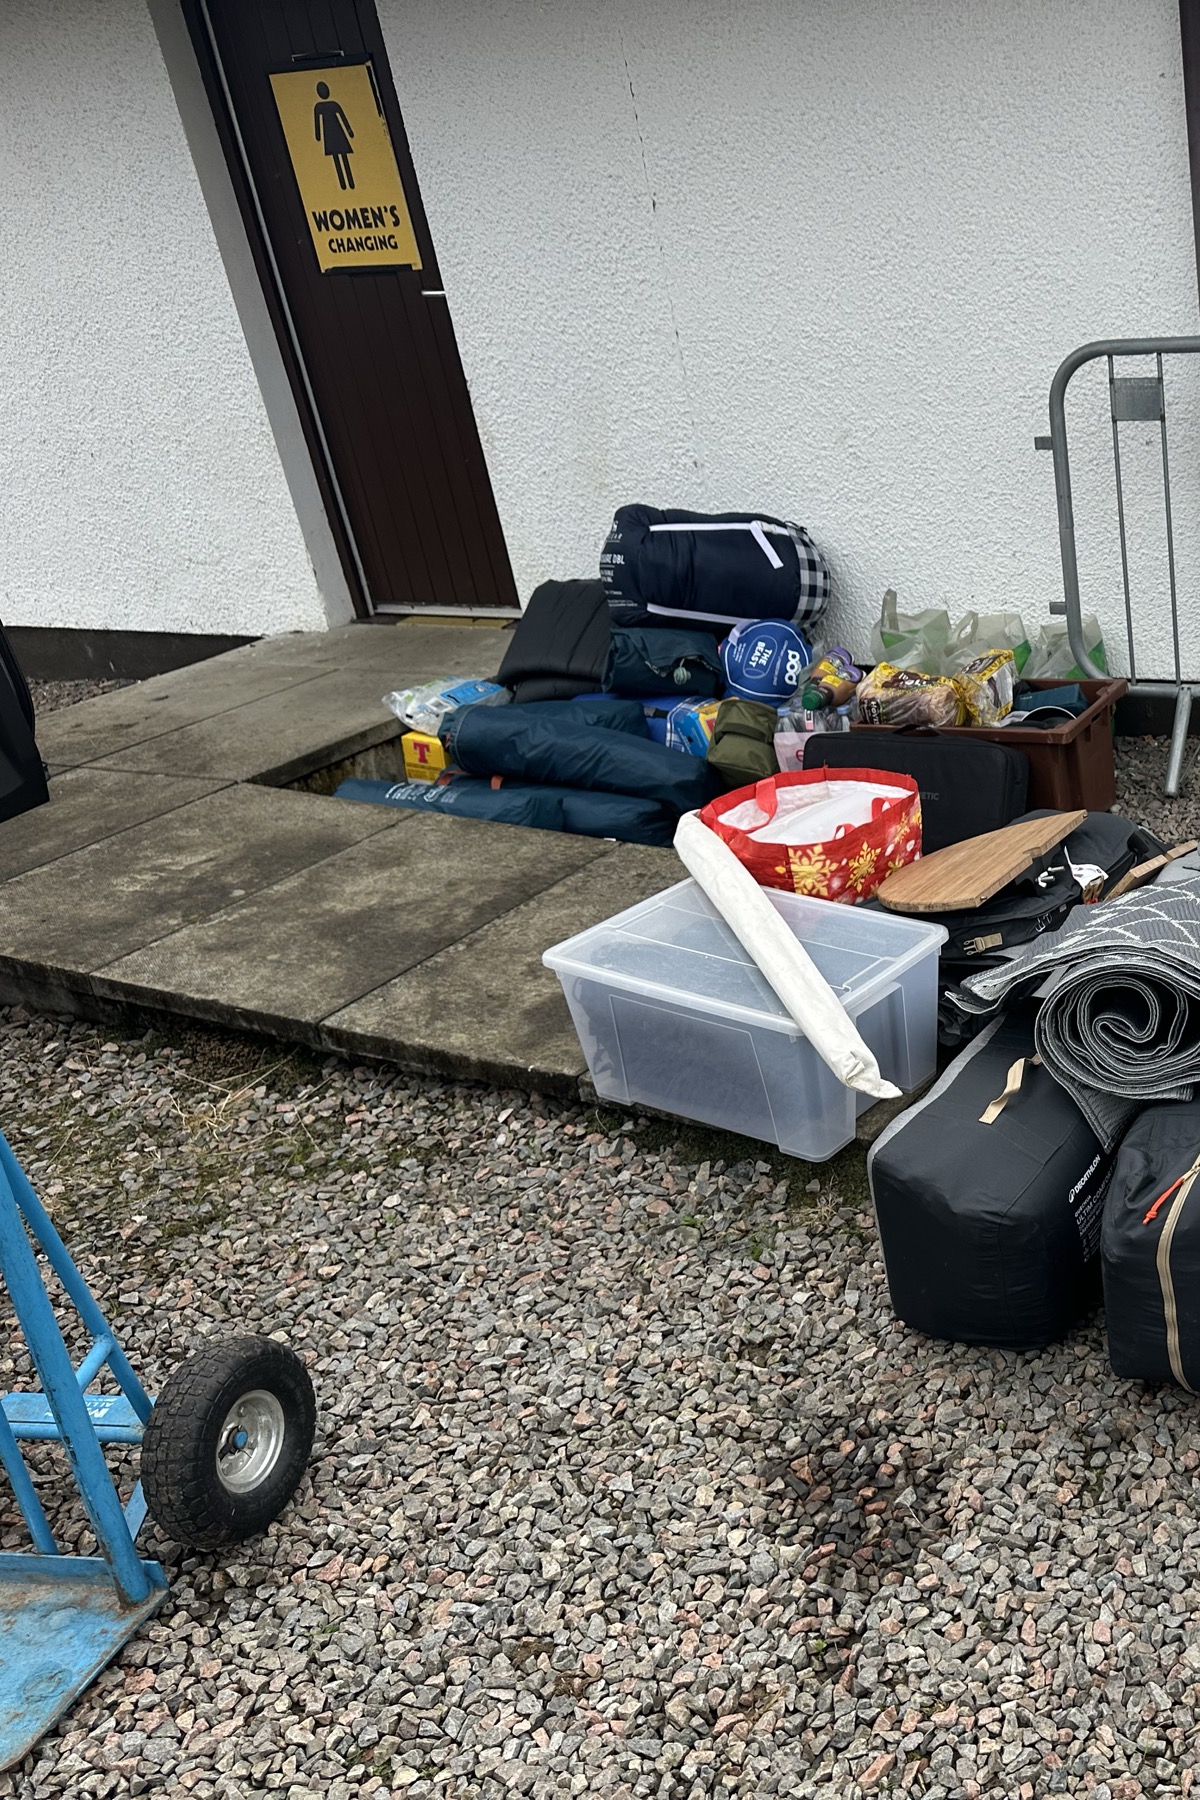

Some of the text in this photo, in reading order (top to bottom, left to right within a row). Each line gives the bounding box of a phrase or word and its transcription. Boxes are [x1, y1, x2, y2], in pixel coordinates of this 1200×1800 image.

[311, 204, 401, 233] WOMEN'S
[328, 234, 399, 254] CHANGING
[748, 640, 766, 668] BEAST
[758, 648, 773, 666] THE
[413, 741, 431, 764] T
[1073, 1153, 1101, 1195] DECATHLON
[1075, 1201, 1094, 1226] ULTIM
